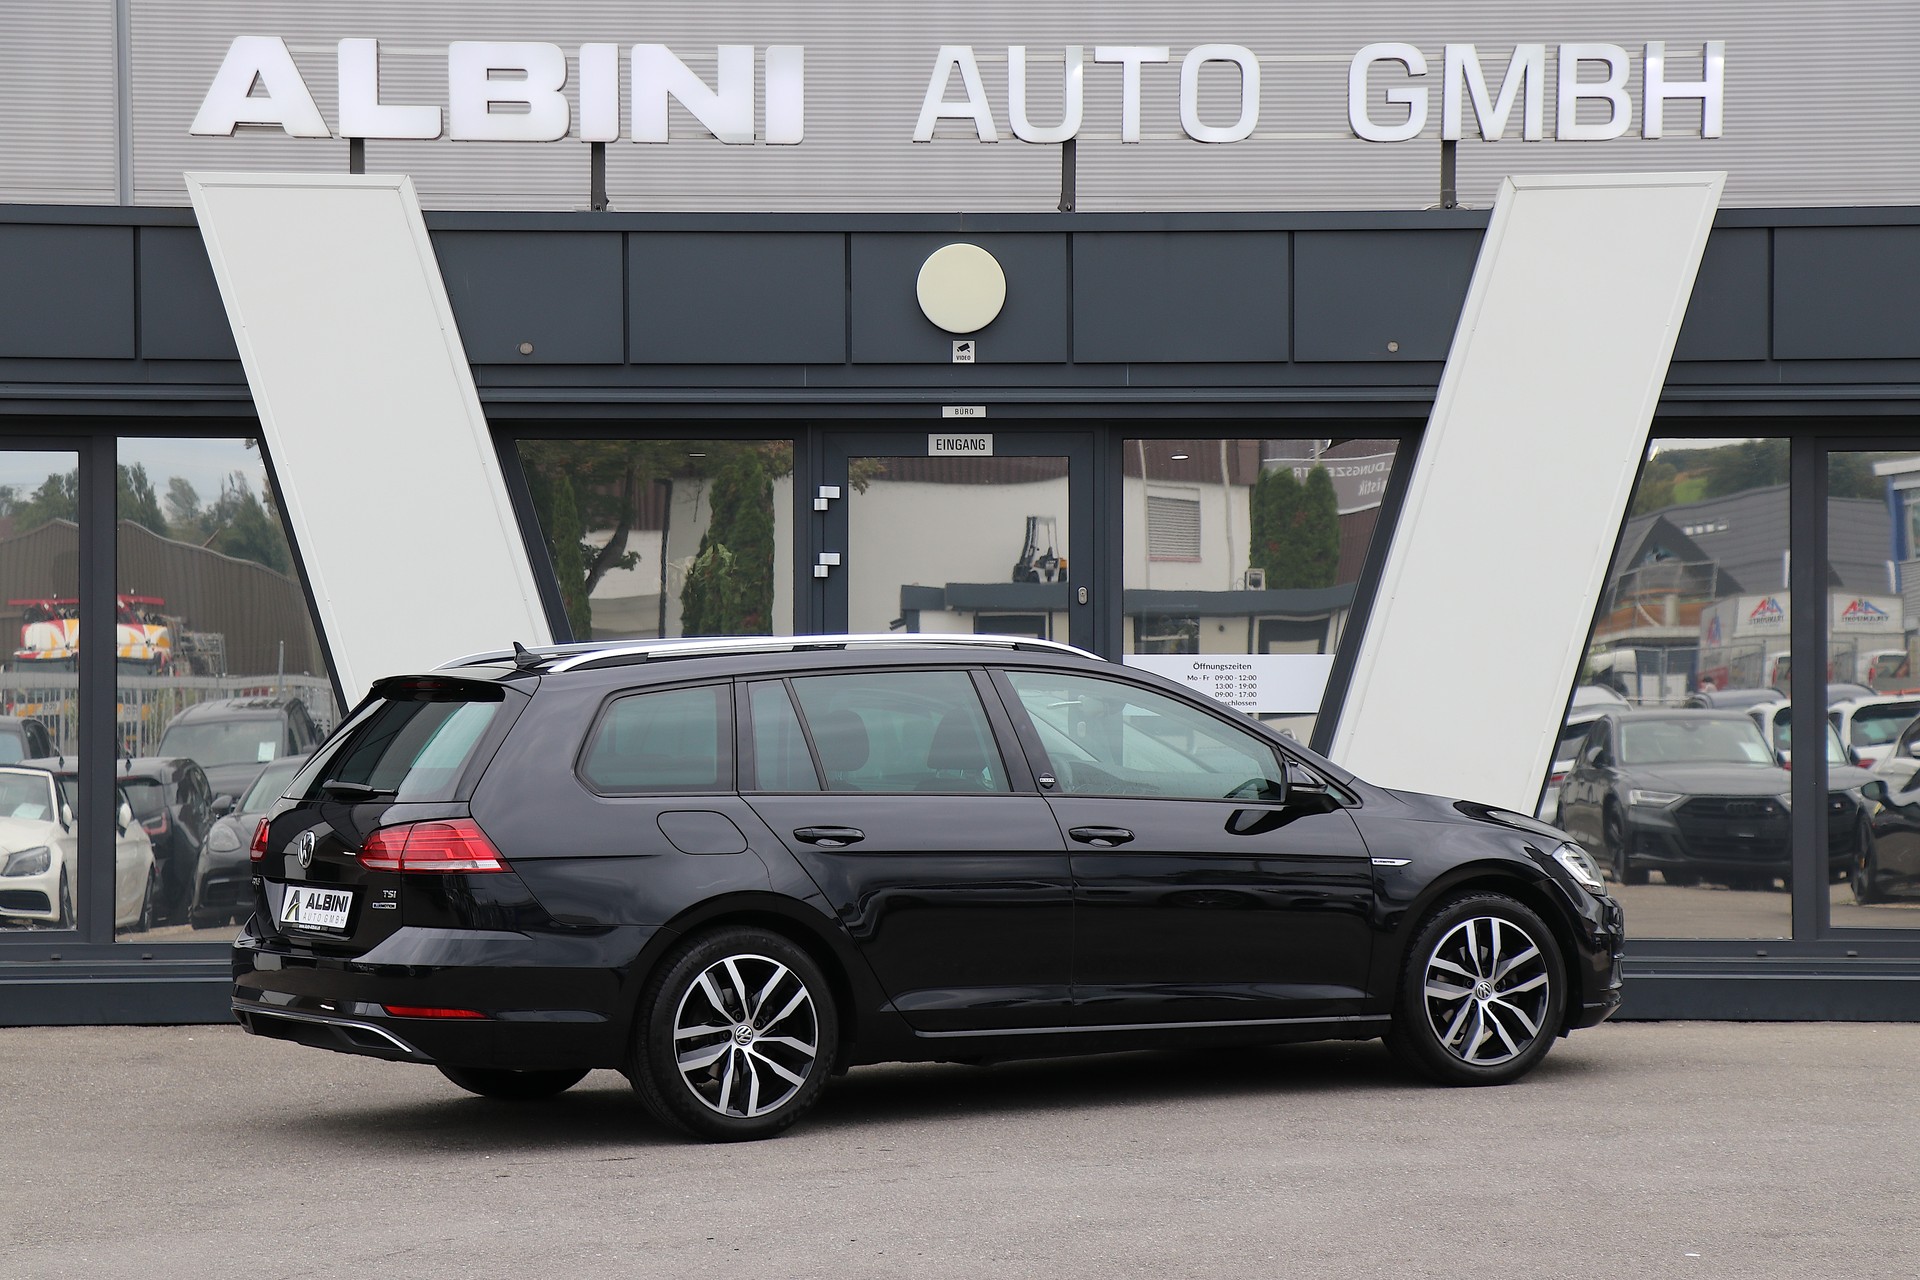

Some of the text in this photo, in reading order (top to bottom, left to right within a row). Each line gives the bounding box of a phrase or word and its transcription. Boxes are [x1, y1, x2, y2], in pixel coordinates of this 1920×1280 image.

[189, 36, 1726, 146] ALBINI AUTO GMBH
[954, 407, 974, 415] BÜRO
[936, 438, 986, 451] EINGANG
[1193, 661, 1252, 671] Öffnungszeiten
[382, 889, 397, 899] TSI
[306, 893, 349, 912] ALBINI
[303, 911, 346, 924] AUTO GMBH
